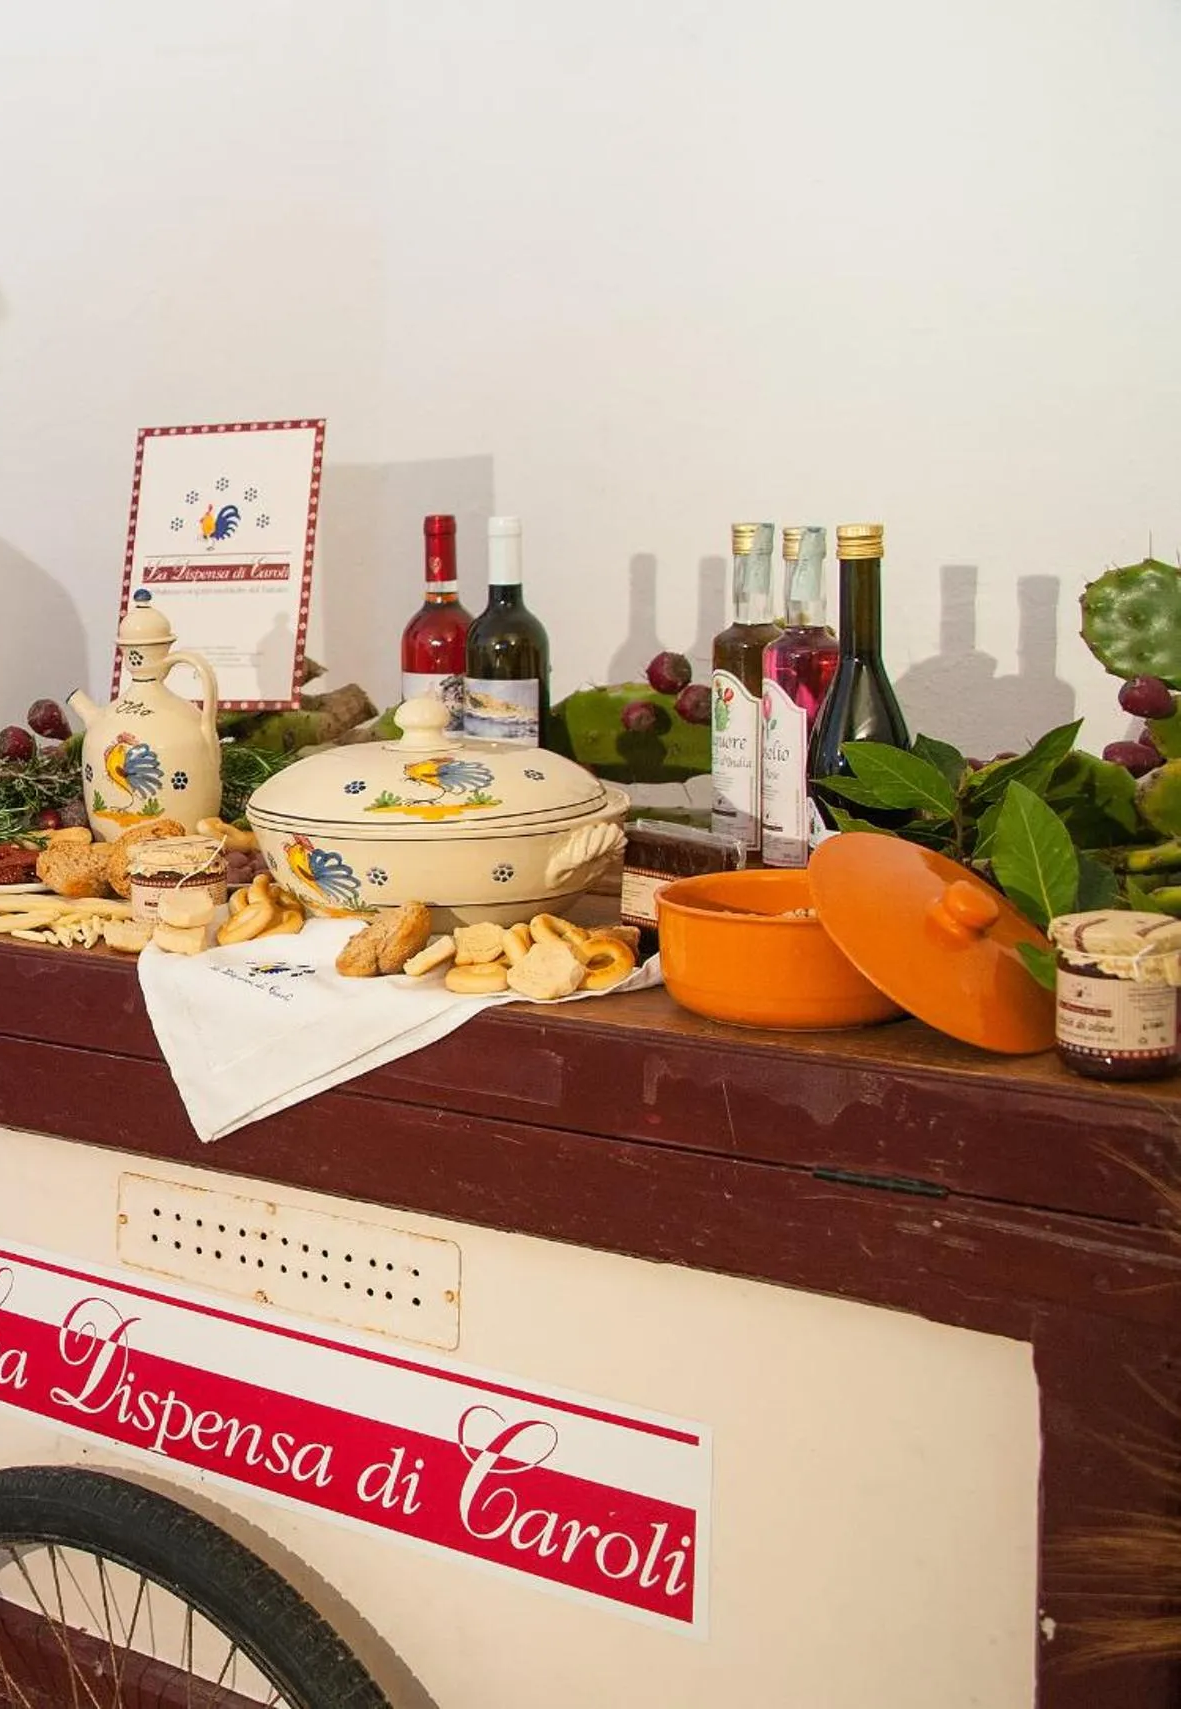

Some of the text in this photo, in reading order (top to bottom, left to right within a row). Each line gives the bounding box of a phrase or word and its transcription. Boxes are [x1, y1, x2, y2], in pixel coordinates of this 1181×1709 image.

[170, 558, 229, 583] Dispensa
[232, 566, 245, 579] di
[50, 1297, 334, 1488] Dispensa
[356, 1447, 426, 1515] di
[457, 1404, 696, 1597] Caroli
